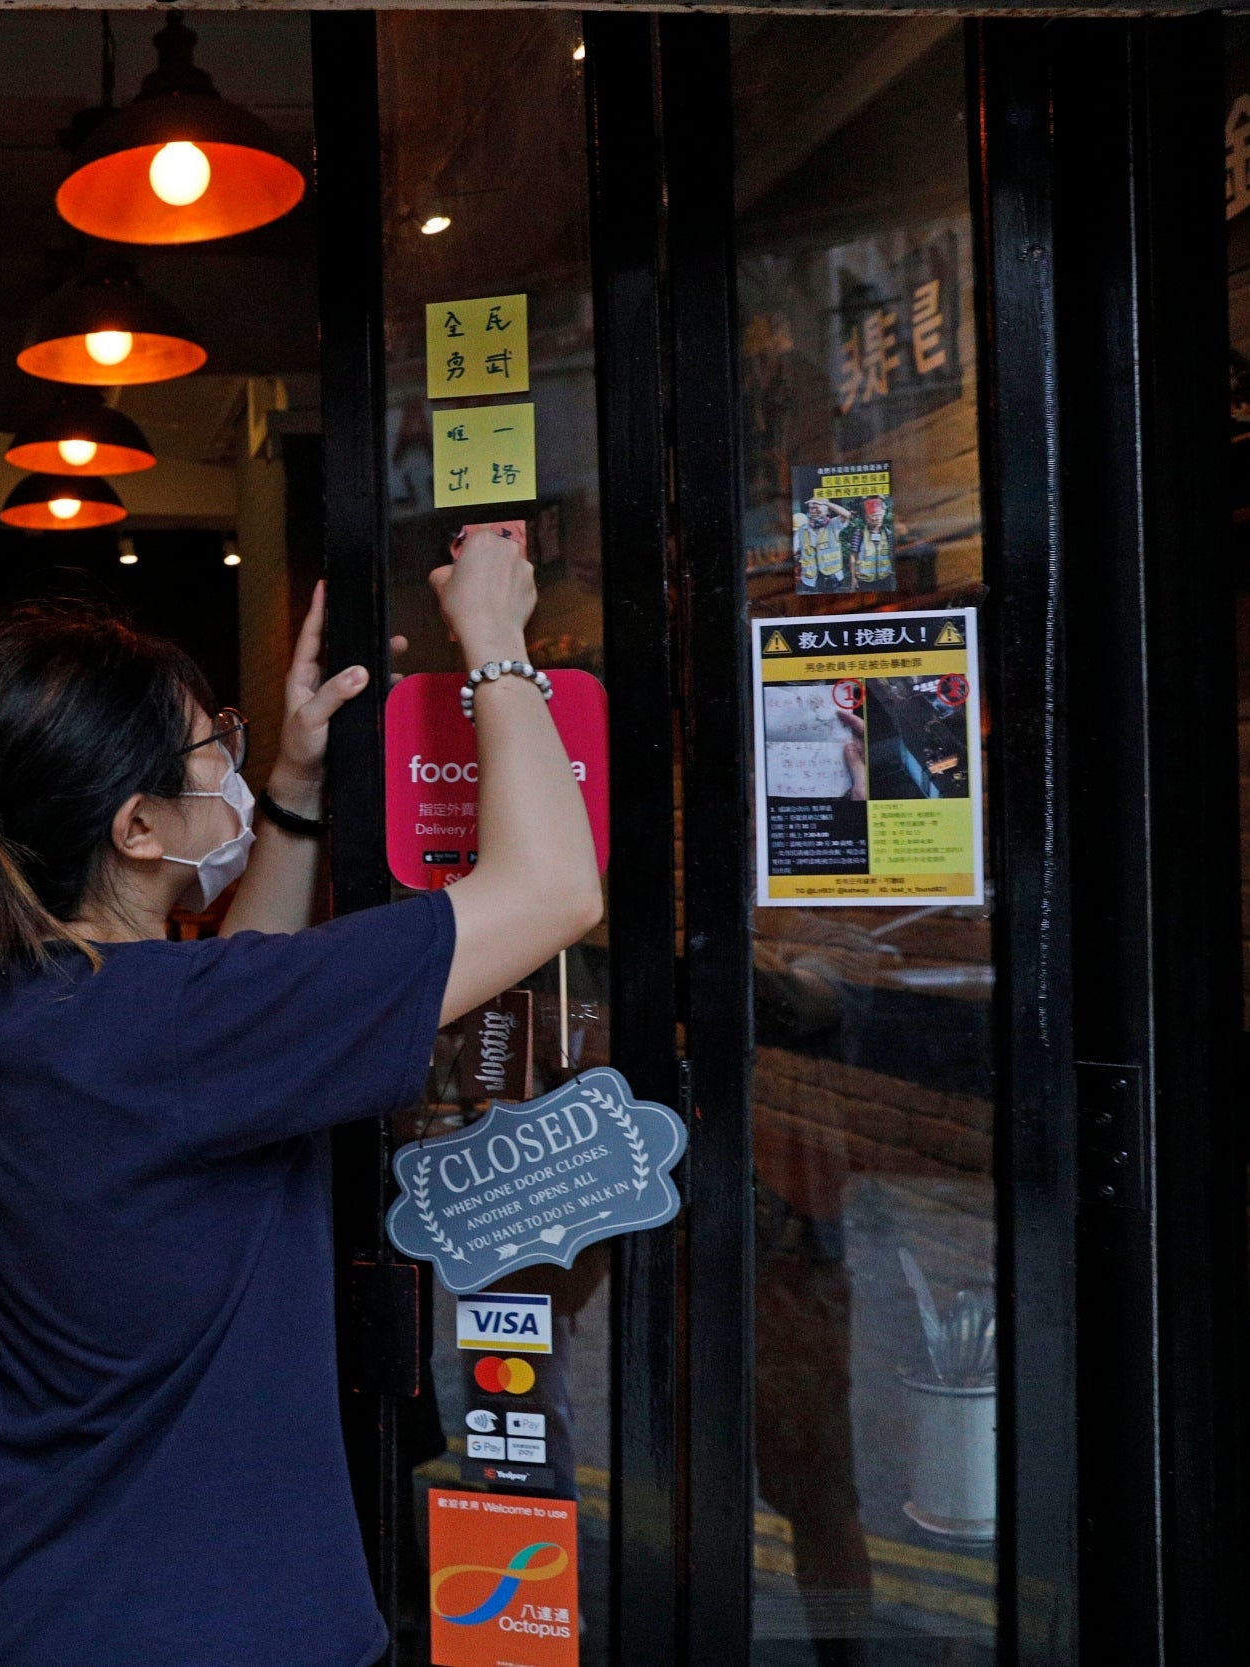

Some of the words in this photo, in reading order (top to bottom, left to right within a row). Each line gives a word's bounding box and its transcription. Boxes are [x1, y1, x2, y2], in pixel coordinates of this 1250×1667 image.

[444, 306, 513, 338] 全民
[446, 348, 513, 381] 勇武
[447, 425, 515, 441] 唯一
[448, 462, 521, 491] 出路
[418, 802, 478, 817] 指定外賣
[415, 823, 467, 838] Delivery
[438, 1100, 600, 1194] CLOSED
[442, 1193, 483, 1219] WHEN
[484, 1183, 512, 1205] ONE
[515, 1167, 555, 1192] DOOR
[467, 1201, 524, 1231] ANOTHER
[572, 1172, 599, 1190] ALL
[465, 1233, 493, 1253] YOU
[492, 1222, 526, 1244] HAVE
[524, 1216, 544, 1232] TO
[542, 1209, 563, 1227] DO
[561, 1203, 577, 1218] IS
[577, 1187, 613, 1209] WALK
[609, 1179, 630, 1198] IN
[468, 1309, 539, 1335] VISA
[482, 1501, 533, 1517] Welcome
[533, 1507, 546, 1518] to
[547, 1509, 568, 1520] use
[520, 1603, 571, 1624] 八達通
[498, 1616, 571, 1639] Octopus
